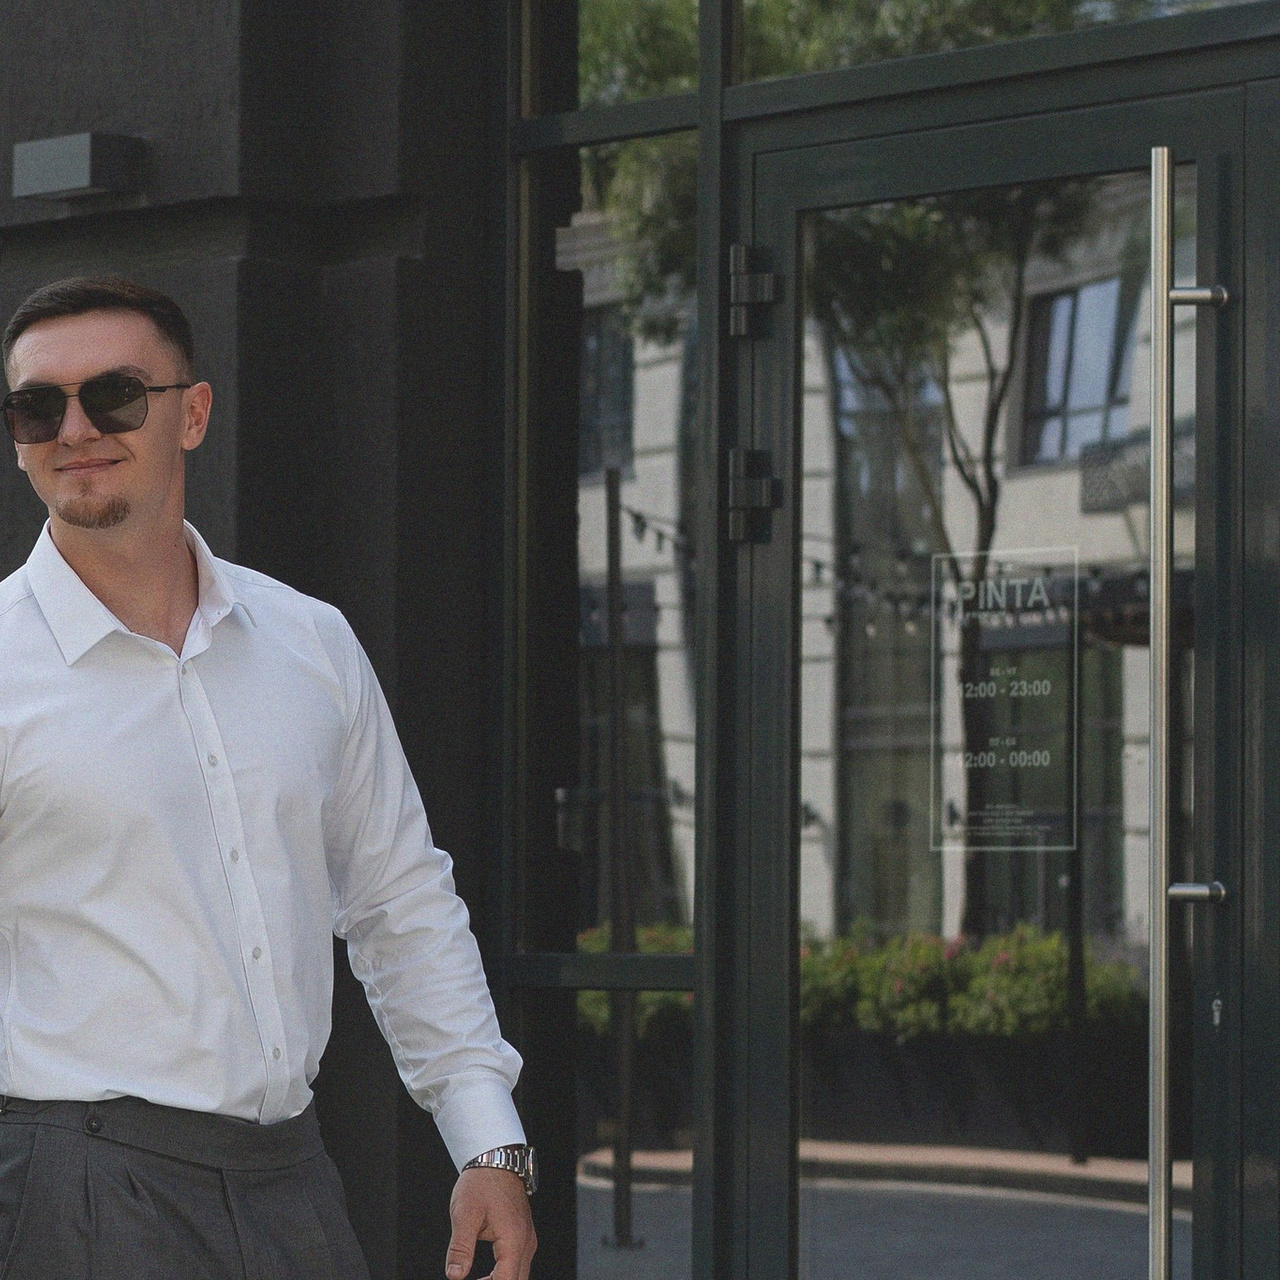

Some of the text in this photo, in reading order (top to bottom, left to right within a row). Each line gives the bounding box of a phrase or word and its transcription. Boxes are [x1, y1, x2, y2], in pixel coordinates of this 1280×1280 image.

[958, 577, 1051, 619] PINTA
[1009, 679, 1052, 697] 23:00
[958, 751, 996, 768] 2:00
[1008, 749, 1051, 767] 00:00
